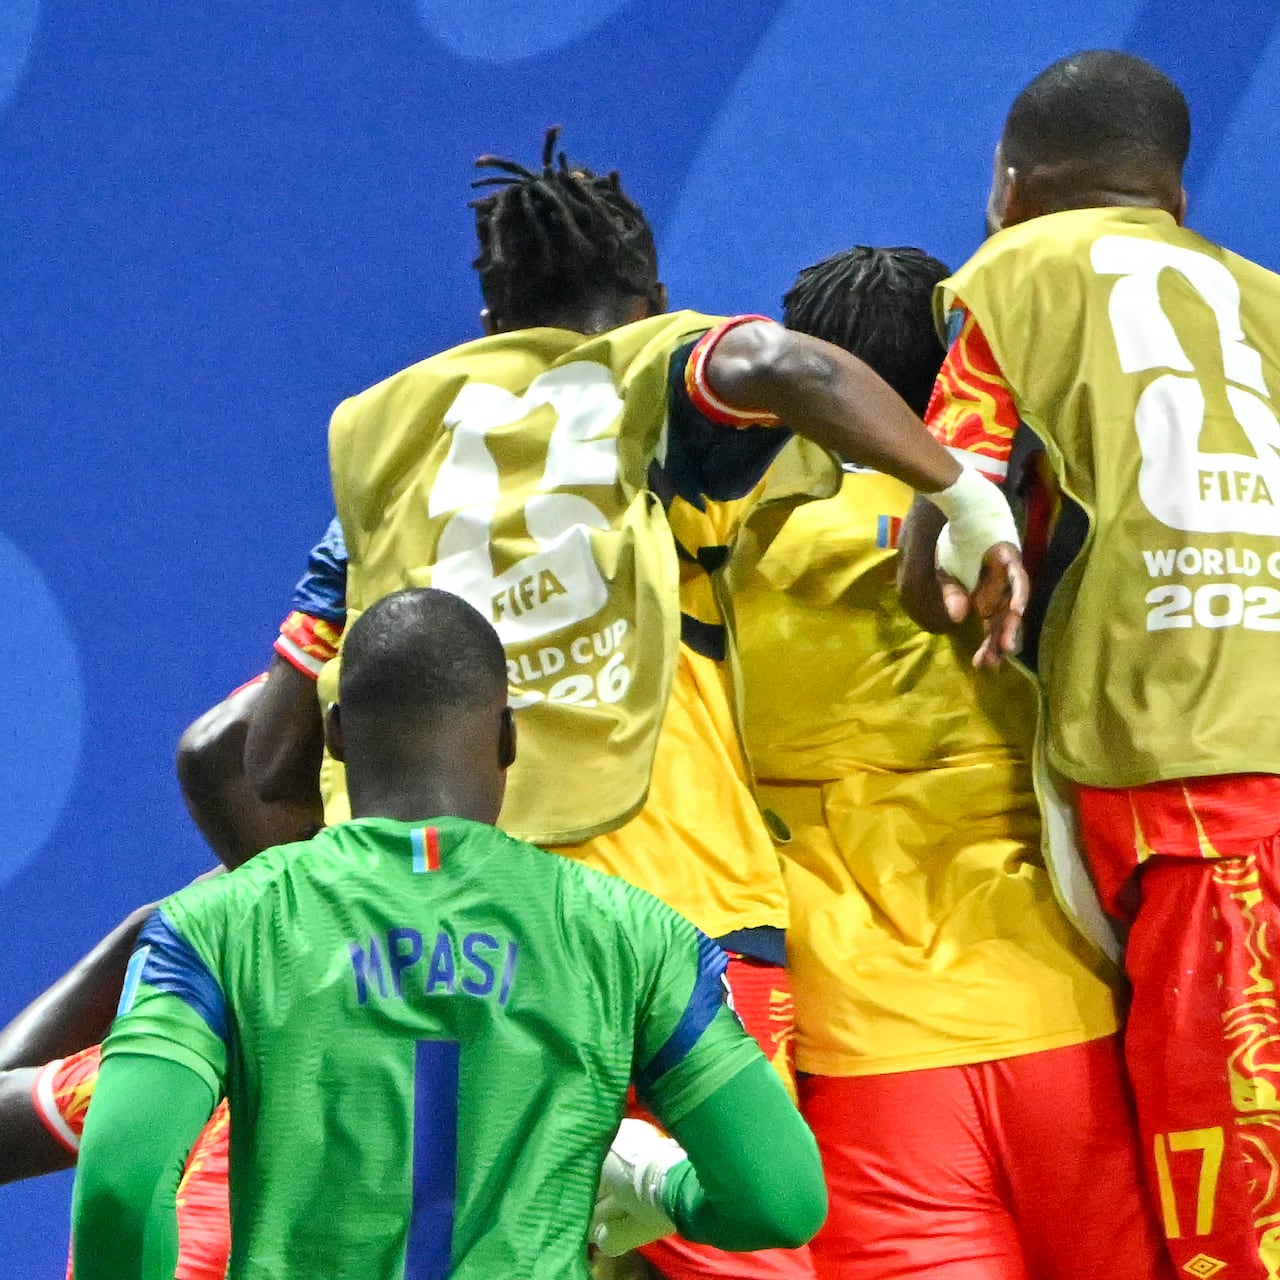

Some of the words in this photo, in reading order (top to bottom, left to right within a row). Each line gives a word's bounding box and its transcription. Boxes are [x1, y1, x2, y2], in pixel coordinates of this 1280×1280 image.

[1198, 470, 1274, 506] FIFA
[1142, 546, 1261, 577] WORLD
[491, 568, 567, 623] FIFA
[506, 646, 565, 684] RLD
[570, 618, 628, 665] CUP
[348, 927, 519, 1006] MPASI
[1153, 1126, 1225, 1239] 17
